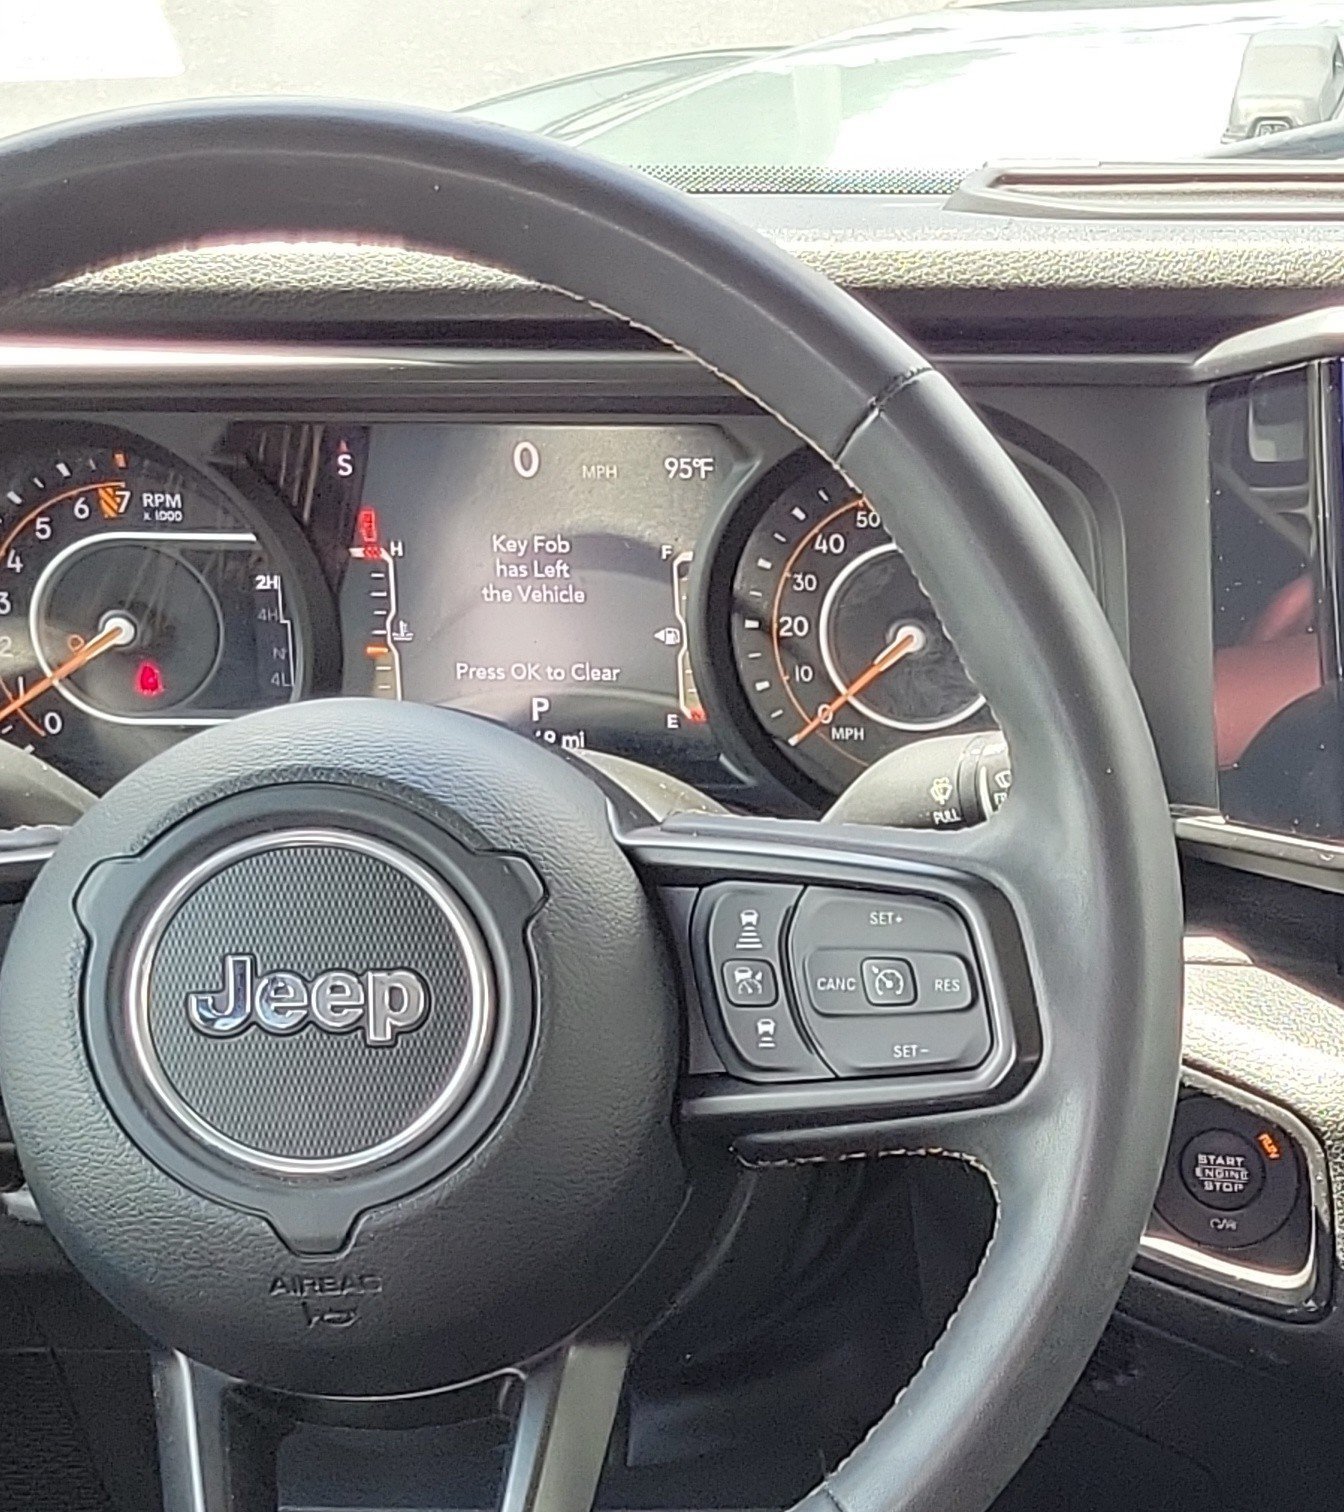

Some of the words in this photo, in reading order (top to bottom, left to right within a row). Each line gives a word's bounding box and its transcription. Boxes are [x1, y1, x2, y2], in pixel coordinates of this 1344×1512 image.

[337, 454, 352, 476] S
[513, 441, 540, 478] 0
[664, 457, 714, 479] 95°F
[582, 465, 618, 479] MPH
[74, 497, 90, 520] 6
[117, 491, 131, 513] 7
[142, 493, 182, 509] RPM
[155, 510, 182, 522] 1000
[856, 512, 881, 528] 50
[35, 517, 52, 540] 5
[390, 541, 404, 557] H
[492, 534, 528, 557] Key
[533, 534, 571, 554] Fob
[661, 545, 672, 559] F
[814, 533, 845, 554] 40
[7, 550, 23, 573] 4
[496, 559, 528, 578] has
[533, 559, 570, 578] Left
[255, 575, 279, 589] 2H
[792, 573, 817, 592] 30
[482, 583, 512, 602] the
[516, 584, 585, 603] Vehicle
[257, 608, 279, 621] 4H
[779, 616, 809, 637] 20
[456, 662, 506, 681] Press
[511, 663, 541, 681] OK
[547, 665, 566, 682] to
[571, 662, 620, 682] Clear
[794, 665, 813, 682] 10
[532, 698, 549, 721] P
[44, 712, 62, 735] 0
[667, 714, 679, 728] E
[561, 731, 585, 749] mi
[831, 728, 865, 741] MPH
[933, 810, 962, 824] PULL
[817, 977, 856, 991] CANC
[935, 978, 960, 992] RES
[190, 955, 427, 1046] Jeep
[1197, 1154, 1245, 1167] START
[1195, 1168, 1250, 1180] ENGINE
[1204, 1181, 1245, 1192] STOP
[268, 1276, 383, 1298] AIRBAG
